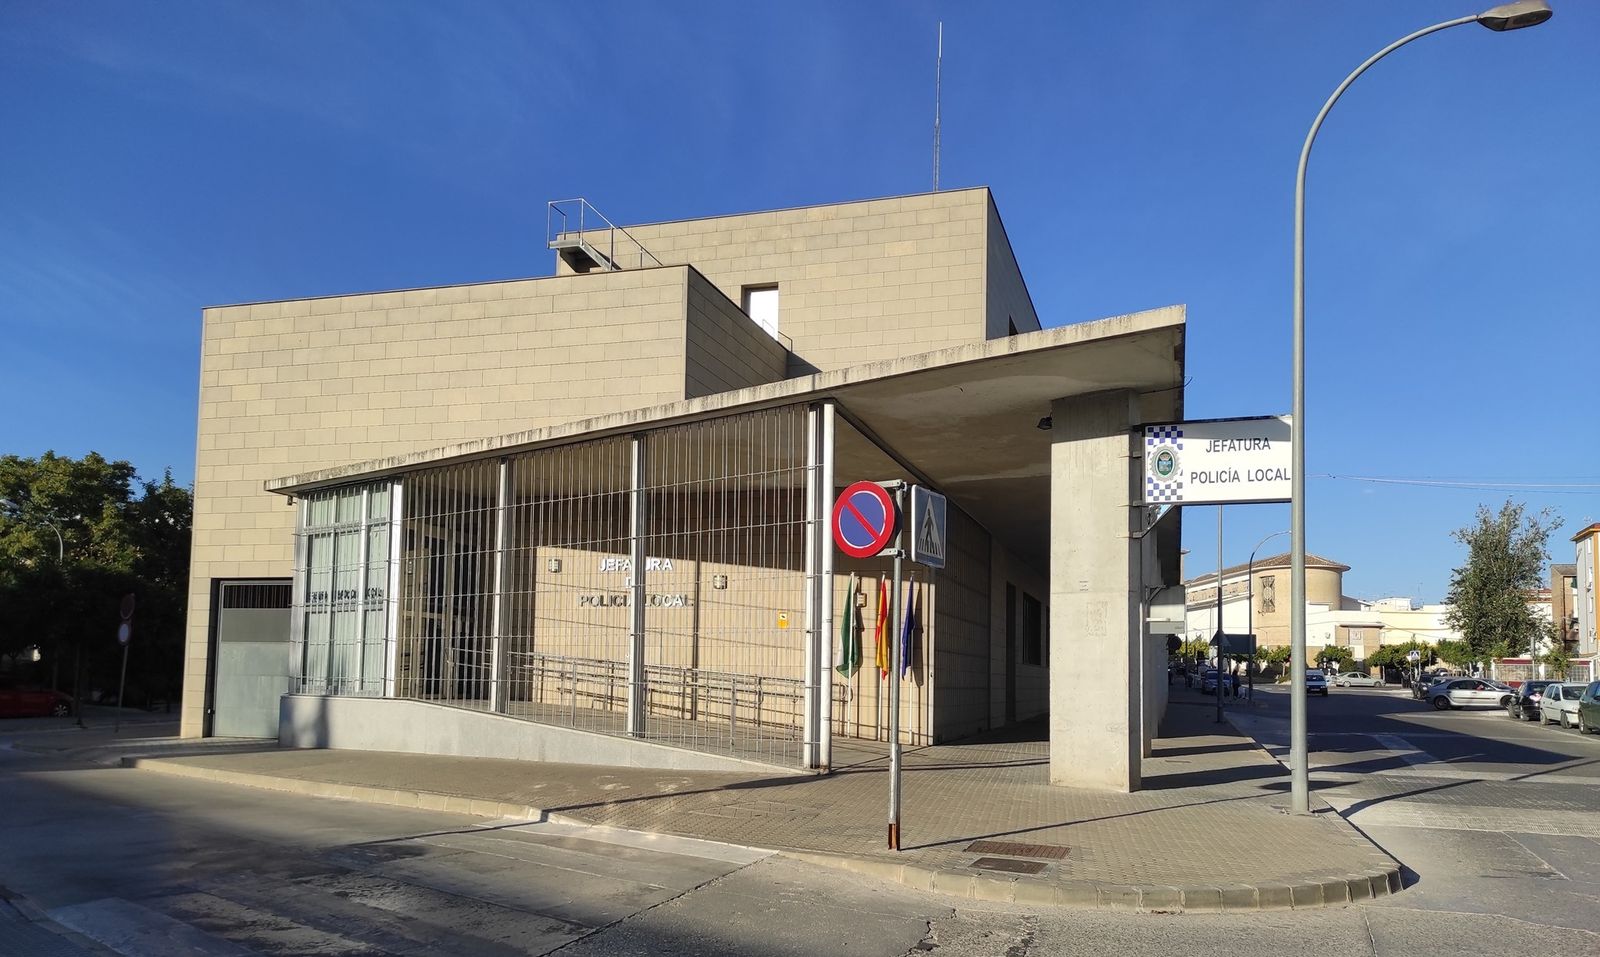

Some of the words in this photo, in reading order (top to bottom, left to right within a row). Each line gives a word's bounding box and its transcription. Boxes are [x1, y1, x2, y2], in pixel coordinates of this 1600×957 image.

[1206, 437, 1271, 453] JEFATURA
[1190, 467, 1240, 484] POLICÍA
[1247, 467, 1291, 482] LOCAL
